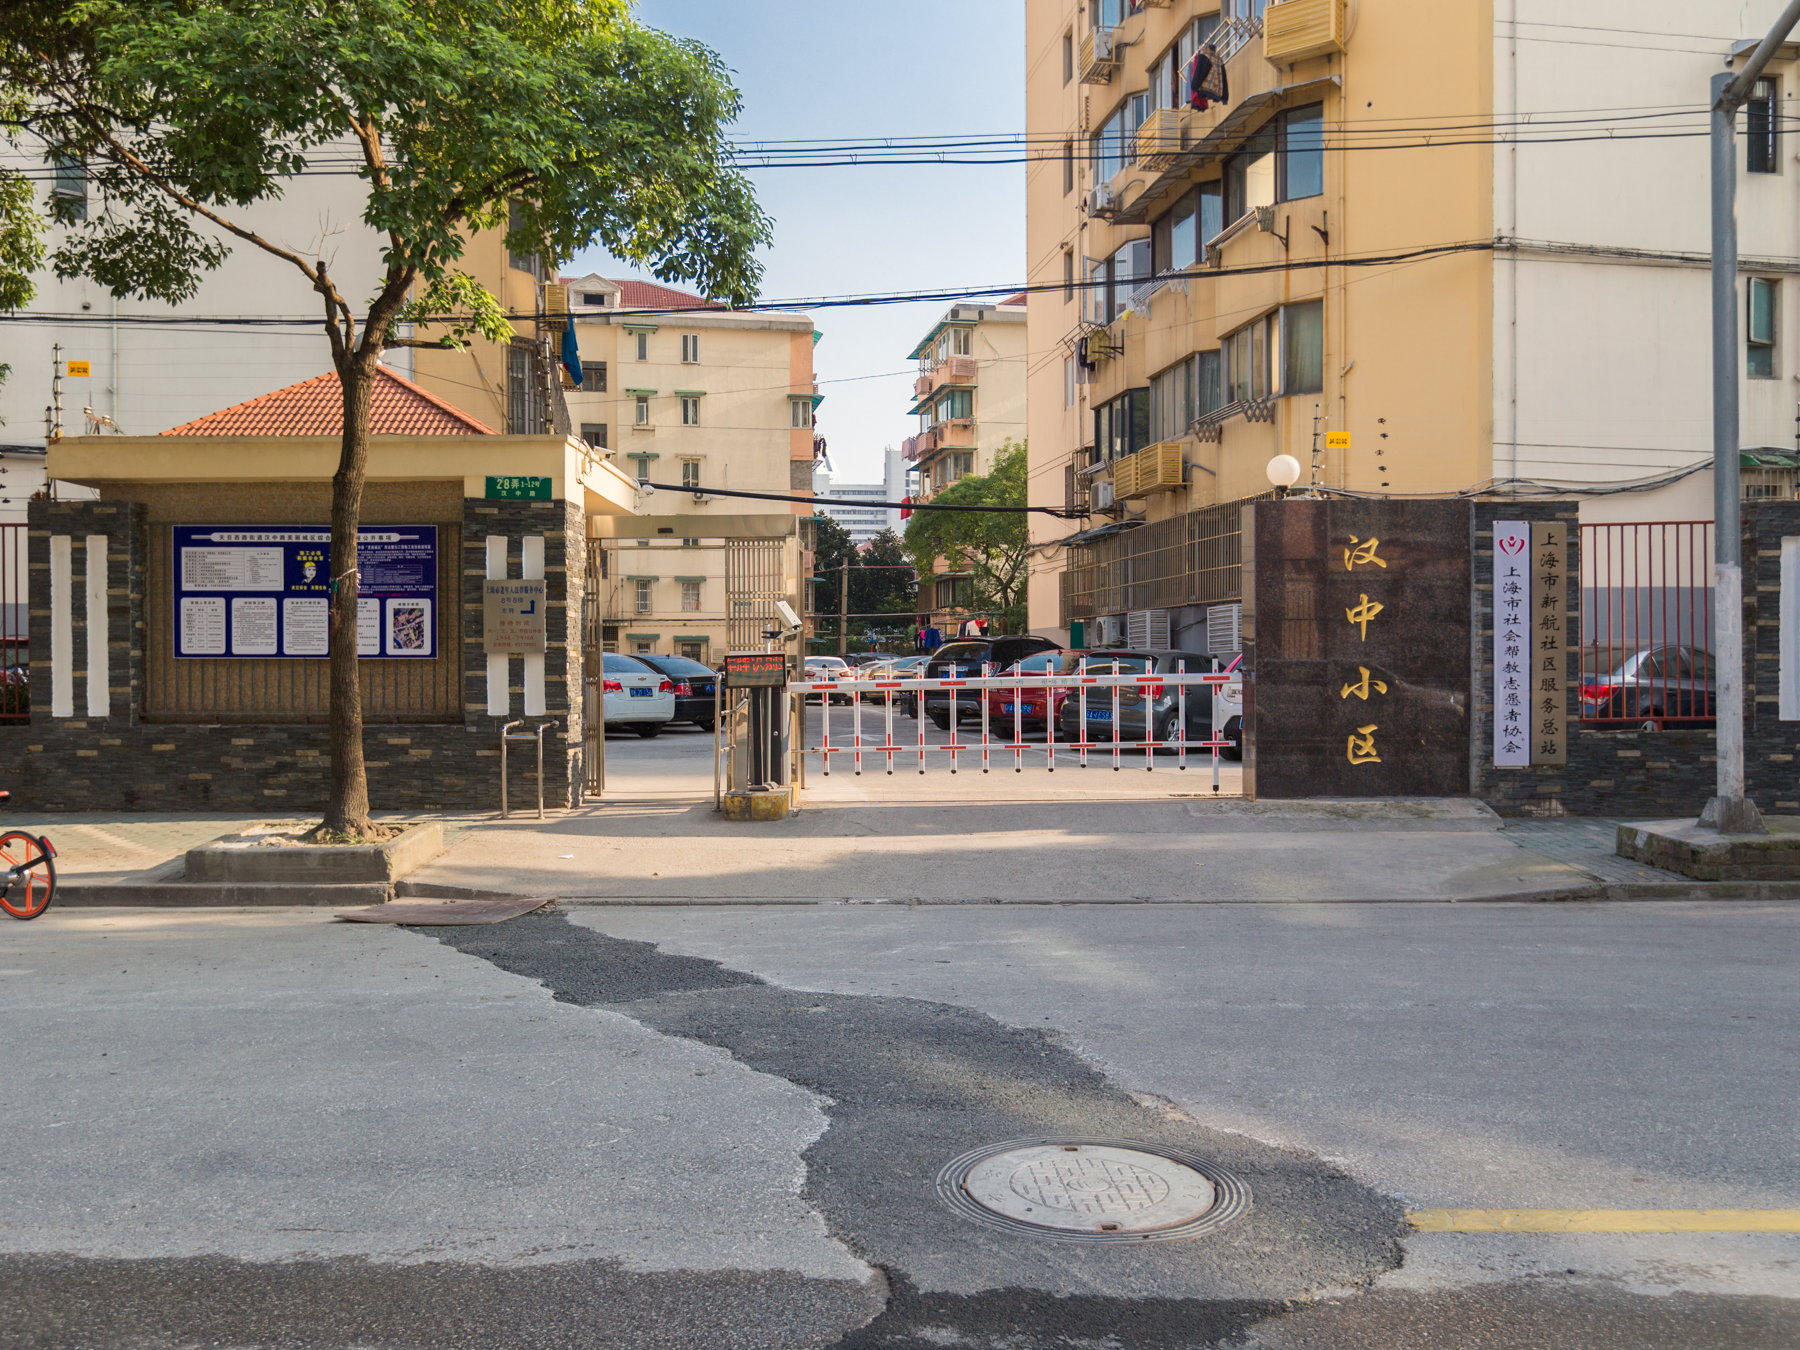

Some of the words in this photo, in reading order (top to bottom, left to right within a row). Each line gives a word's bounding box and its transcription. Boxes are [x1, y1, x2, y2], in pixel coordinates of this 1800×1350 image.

[486, 585, 544, 595] 上海市老年人法律服务中心
[1340, 533, 1388, 765] 汉中小区
[1502, 566, 1522, 754] 上海市社会帮教志愿者协会
[1538, 532, 1560, 755] 上海市新航社区服务总站
